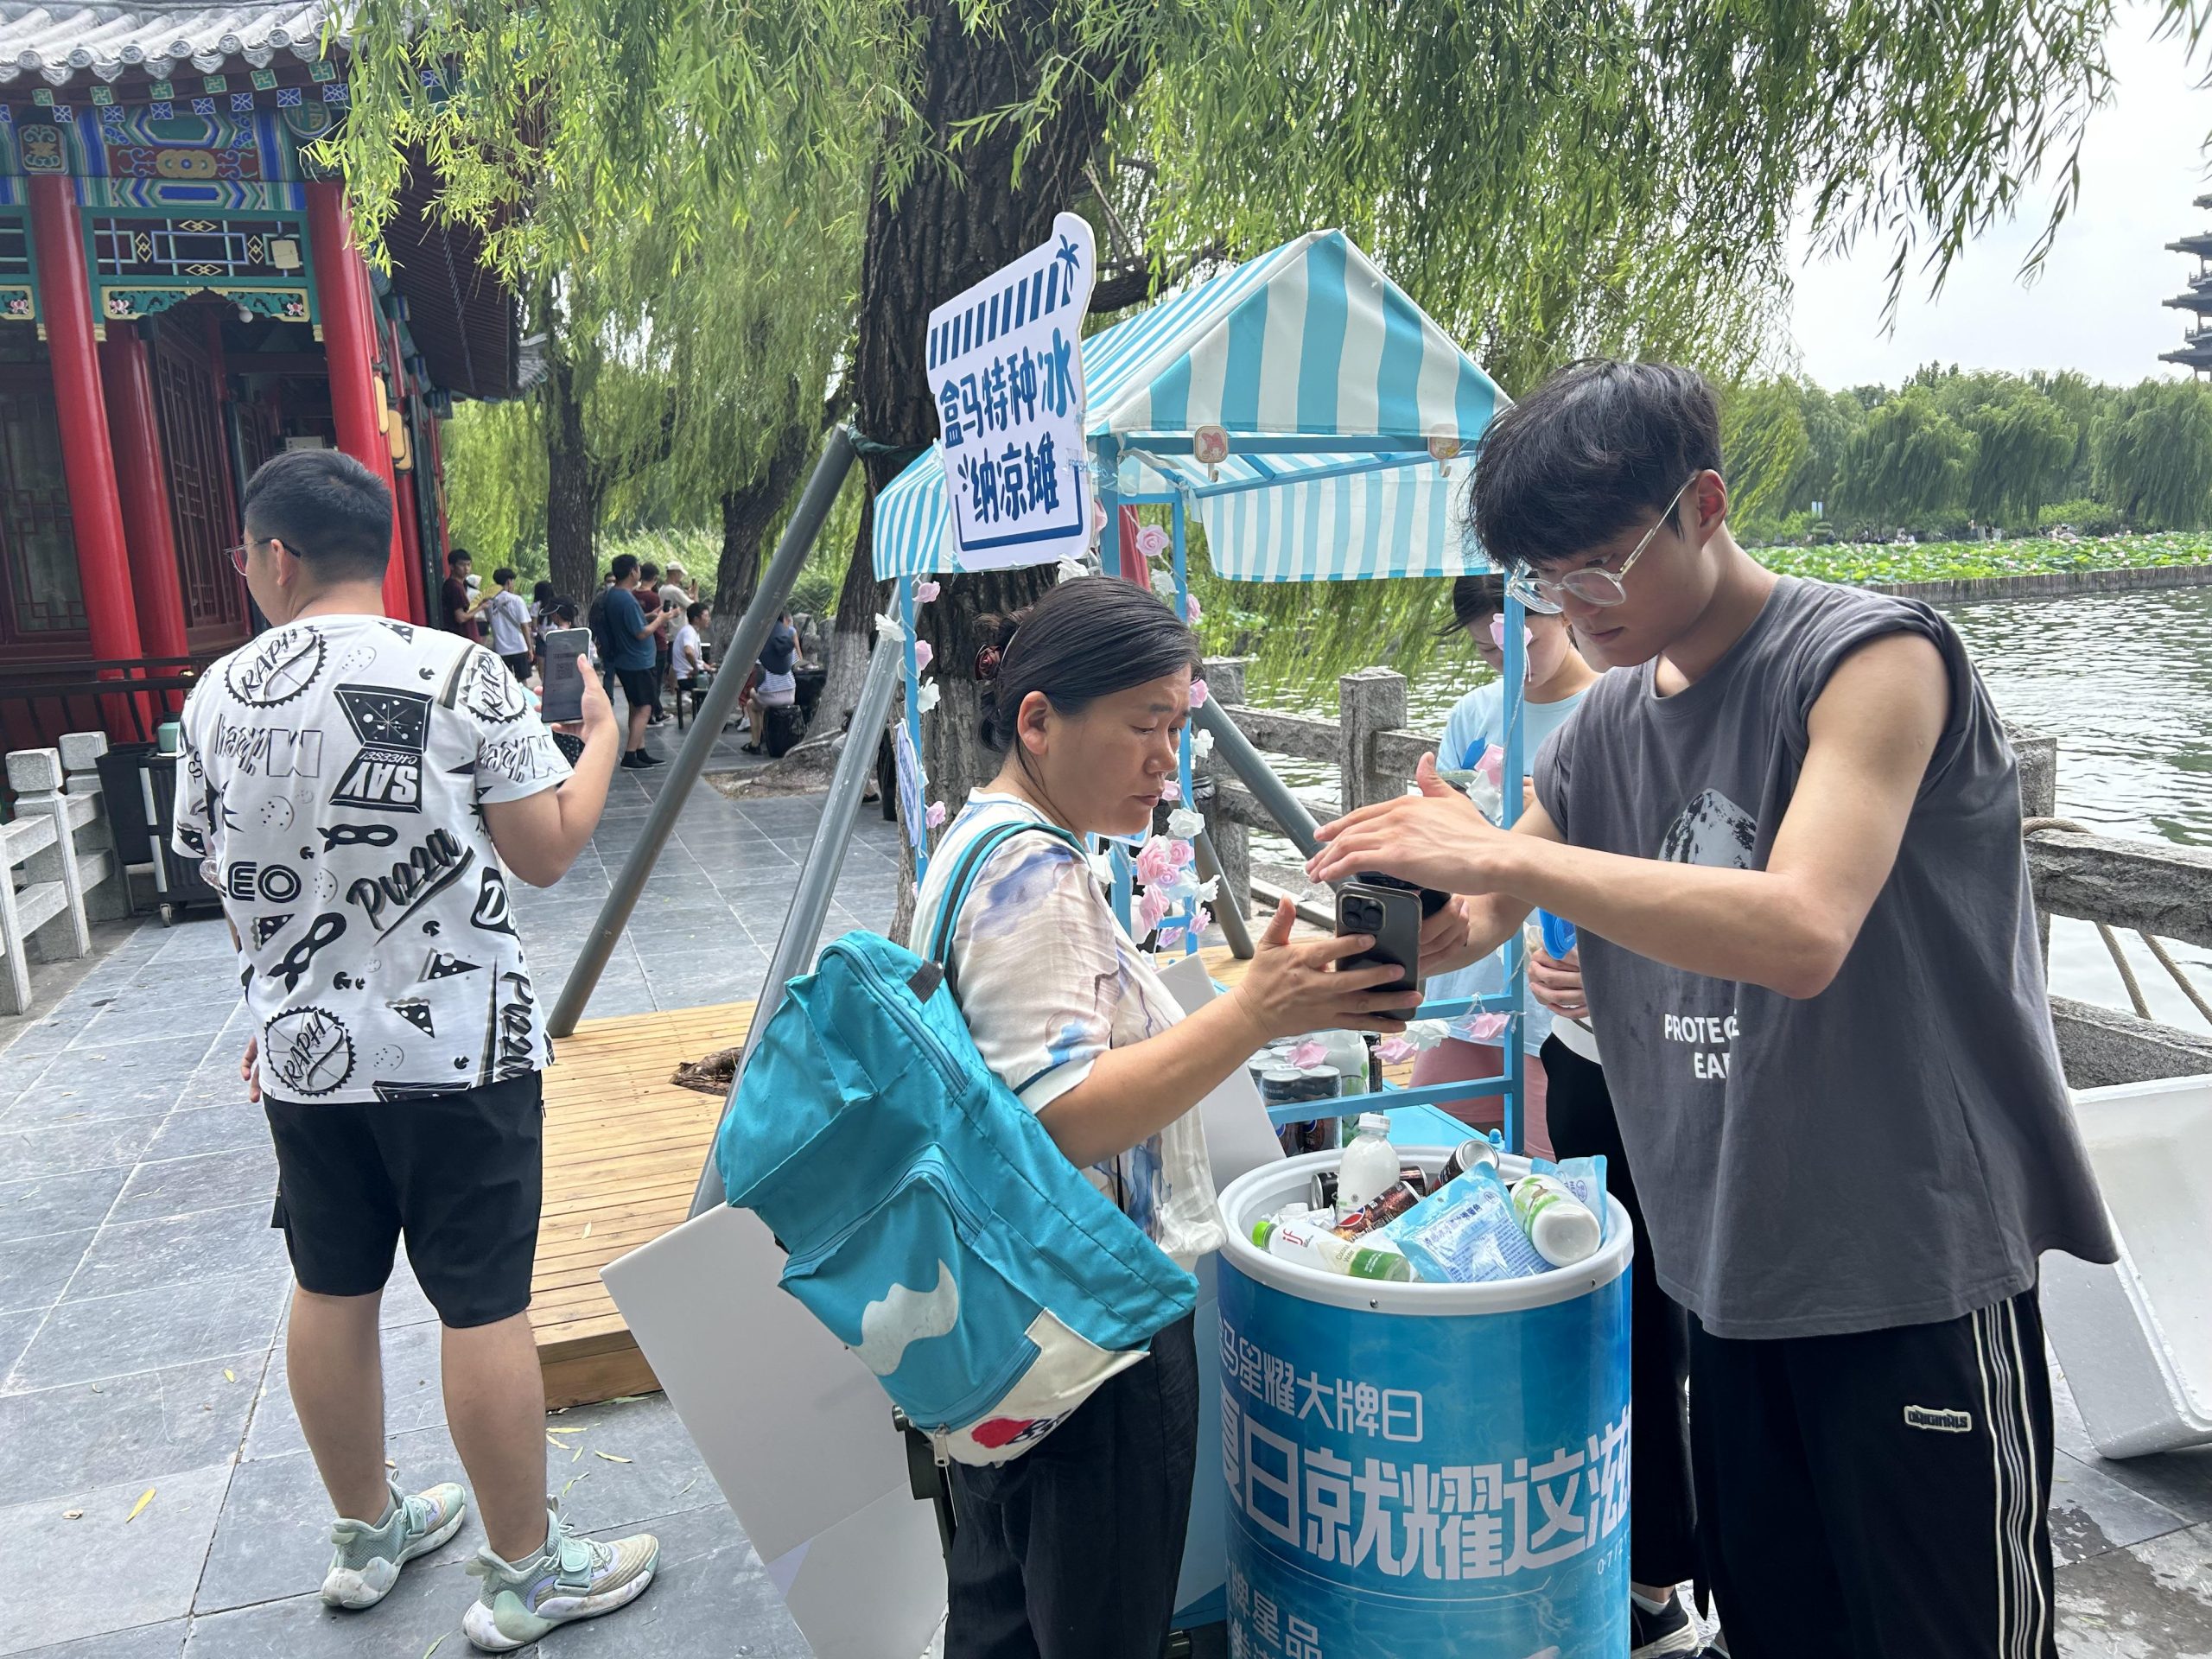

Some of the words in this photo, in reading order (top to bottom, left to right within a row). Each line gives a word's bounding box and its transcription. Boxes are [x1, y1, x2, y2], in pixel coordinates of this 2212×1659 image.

[940, 327, 1076, 448] 盒马特种冰
[970, 431, 1059, 524] 纳凉摊
[346, 761, 419, 804] SAY
[219, 861, 302, 904] EO
[283, 1010, 327, 1089] RAPH
[1283, 1228, 1304, 1246] if
[1218, 1317, 1422, 1443] 马星耀大牌日
